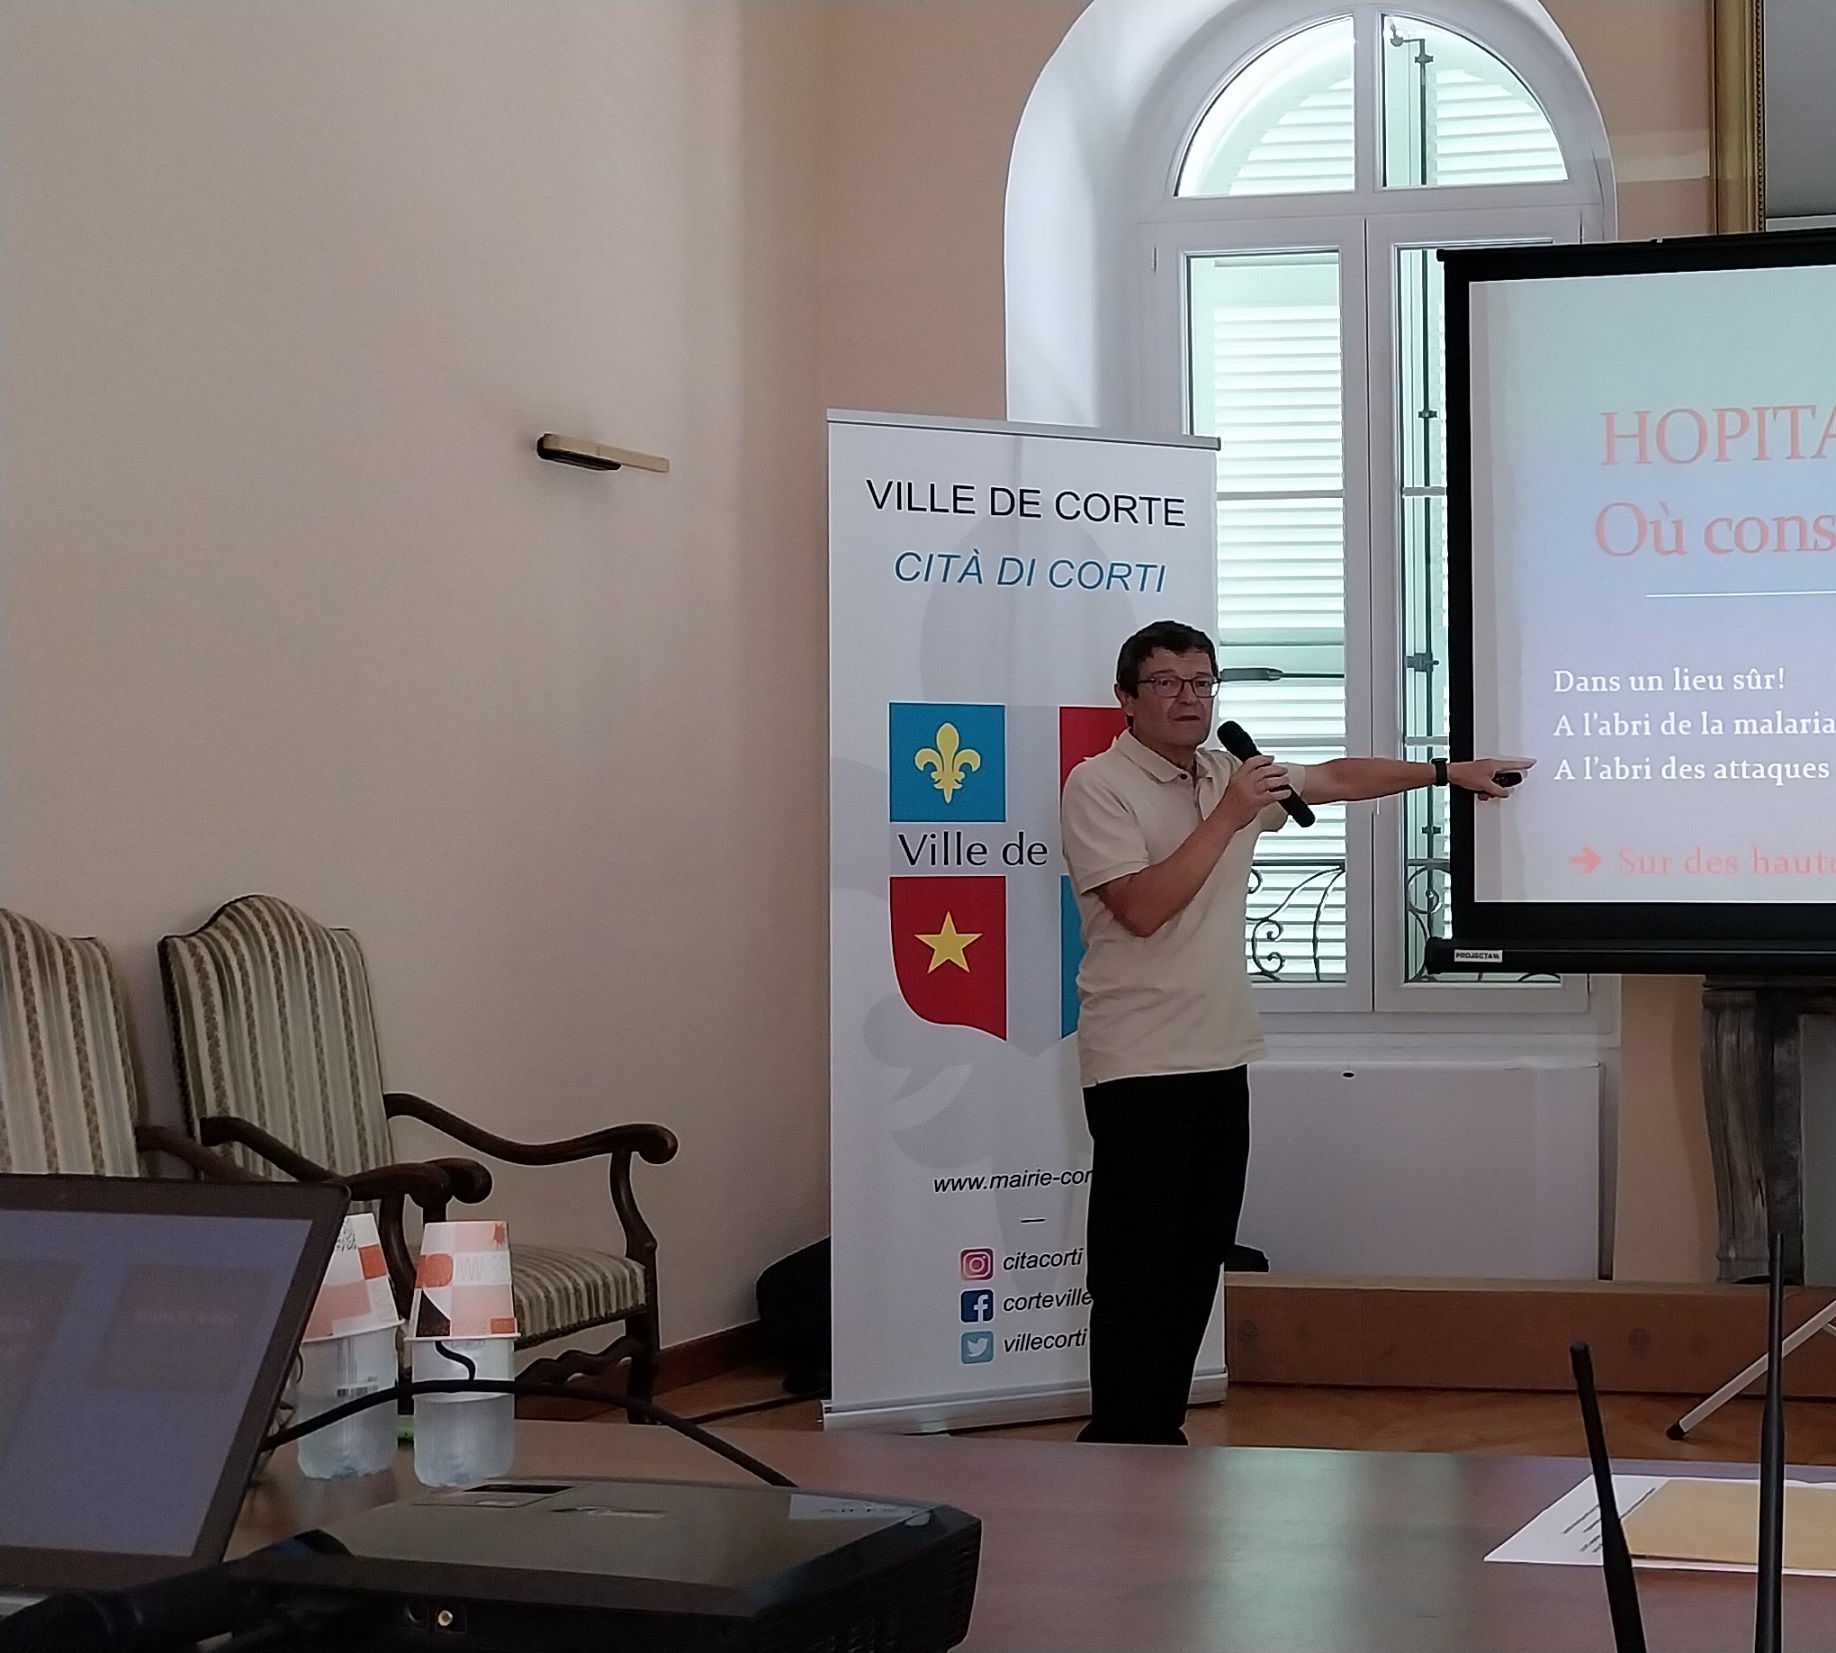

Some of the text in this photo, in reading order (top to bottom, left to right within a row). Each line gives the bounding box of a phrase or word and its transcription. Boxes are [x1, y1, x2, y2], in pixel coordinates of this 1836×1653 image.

[866, 479, 1186, 527] VILLE DE CORTE
[1595, 501, 1687, 557] Où
[895, 548, 1167, 593] CITÀ DI CORTI
[1553, 667, 1785, 692] Dans un lieu sûr!
[1553, 715, 1575, 737] A
[1583, 712, 1651, 736] l'abri
[1660, 711, 1692, 736] de
[1701, 711, 1725, 735] la
[1553, 759, 1575, 780] A
[1583, 756, 1652, 780] l'abri
[1661, 756, 1706, 780] des
[1713, 758, 1830, 786] attaques
[898, 831, 1048, 867] Ville de
[1619, 847, 1673, 875] Sur
[1685, 845, 1739, 875] des
[933, 1169, 1093, 1193] www.mairie-cor
[1003, 1247, 1084, 1270] citacorti
[1003, 1288, 1092, 1312] corteville
[1003, 1328, 1087, 1353] villecorti
